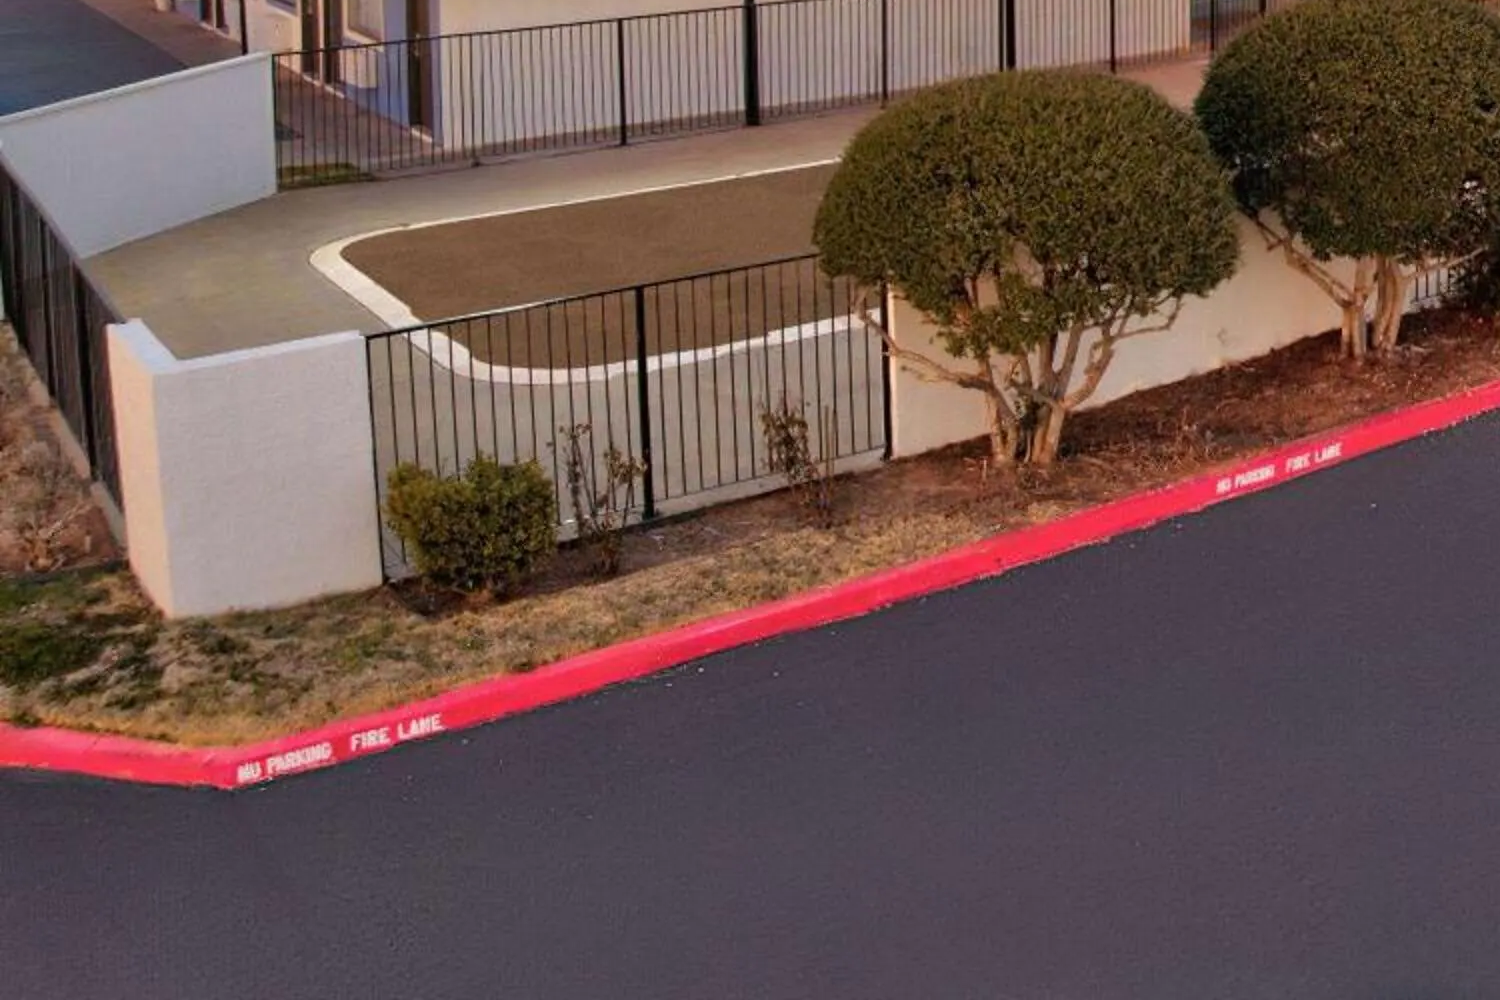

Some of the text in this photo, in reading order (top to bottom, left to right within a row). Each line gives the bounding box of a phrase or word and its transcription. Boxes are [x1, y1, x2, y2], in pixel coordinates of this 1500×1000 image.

[236, 713, 444, 784] NO PARKING FIRE LANE
